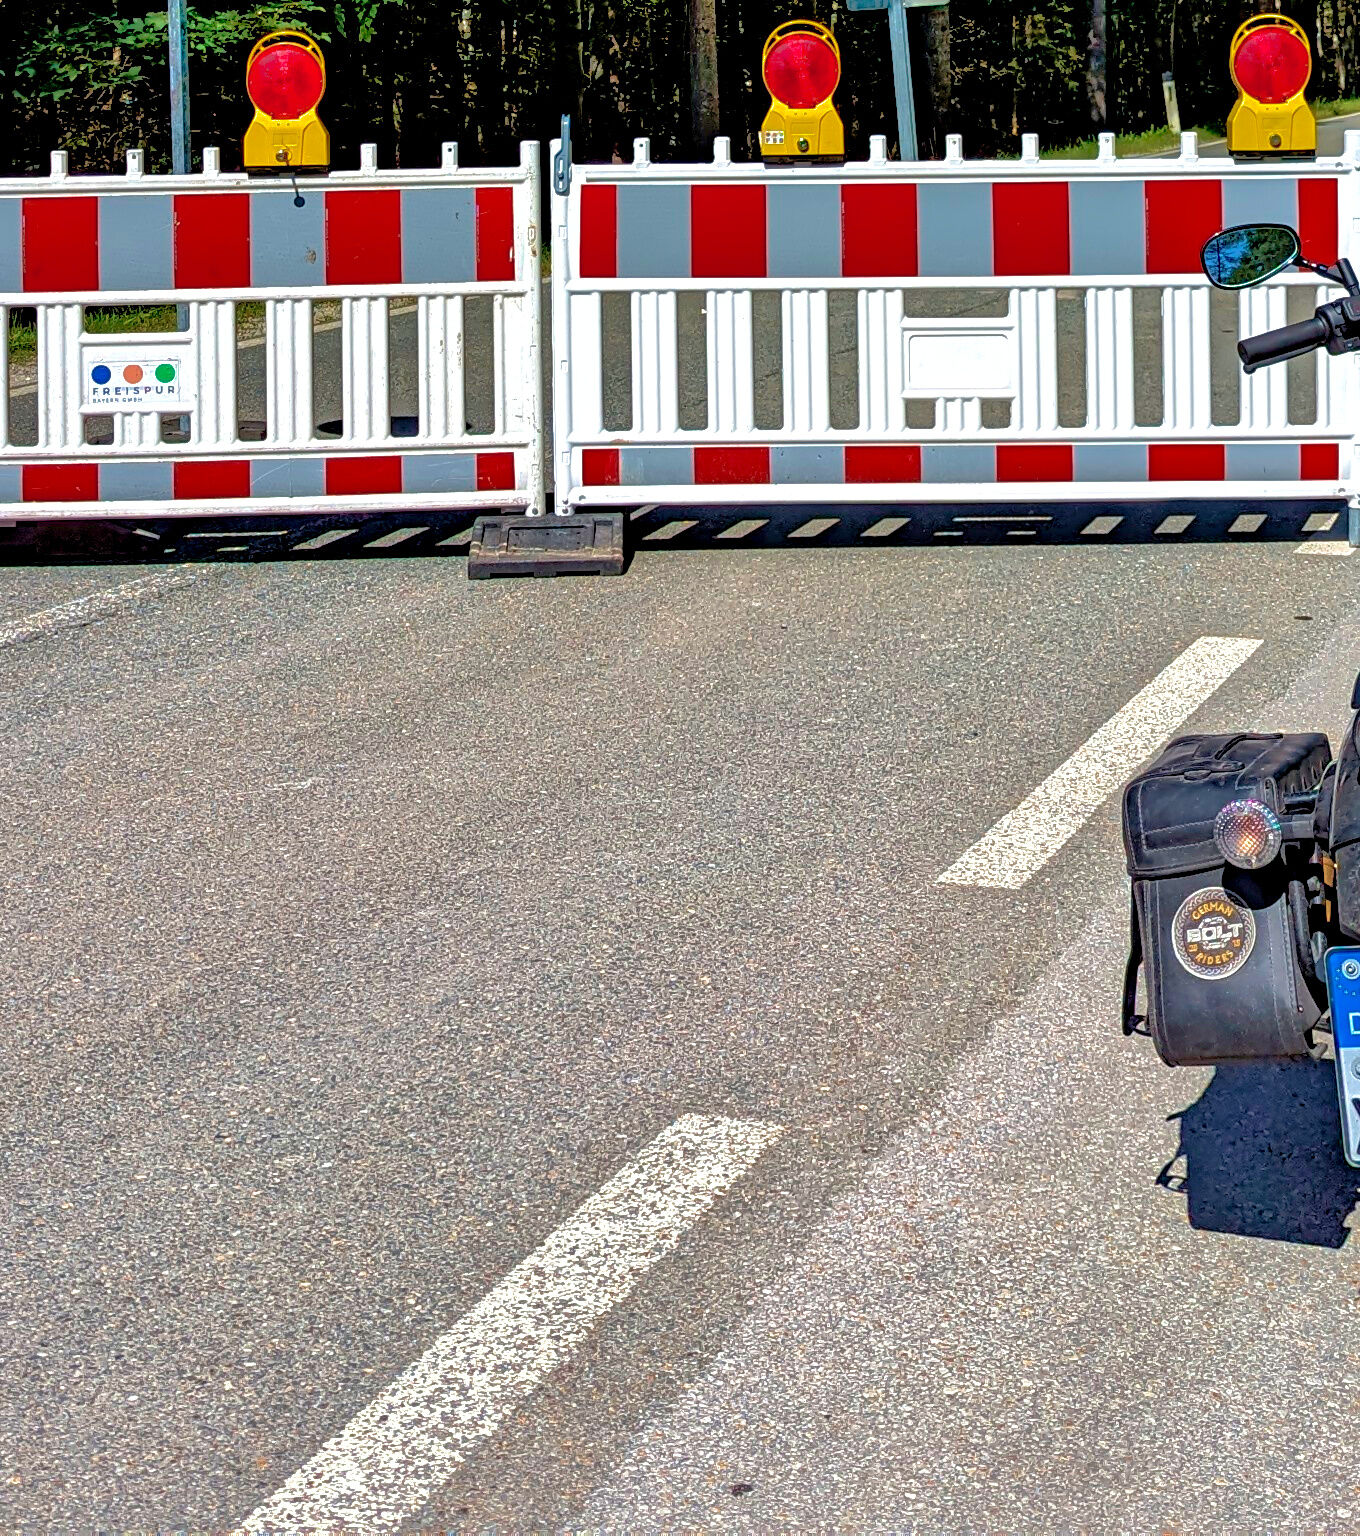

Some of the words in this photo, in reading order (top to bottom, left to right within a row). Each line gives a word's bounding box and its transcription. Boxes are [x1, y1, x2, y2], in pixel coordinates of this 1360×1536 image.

[92, 385, 175, 396] FREISPUR
[1191, 902, 1234, 920] GERMAN
[1186, 923, 1243, 943] BOLT
[1195, 950, 1234, 965] RIDERS
